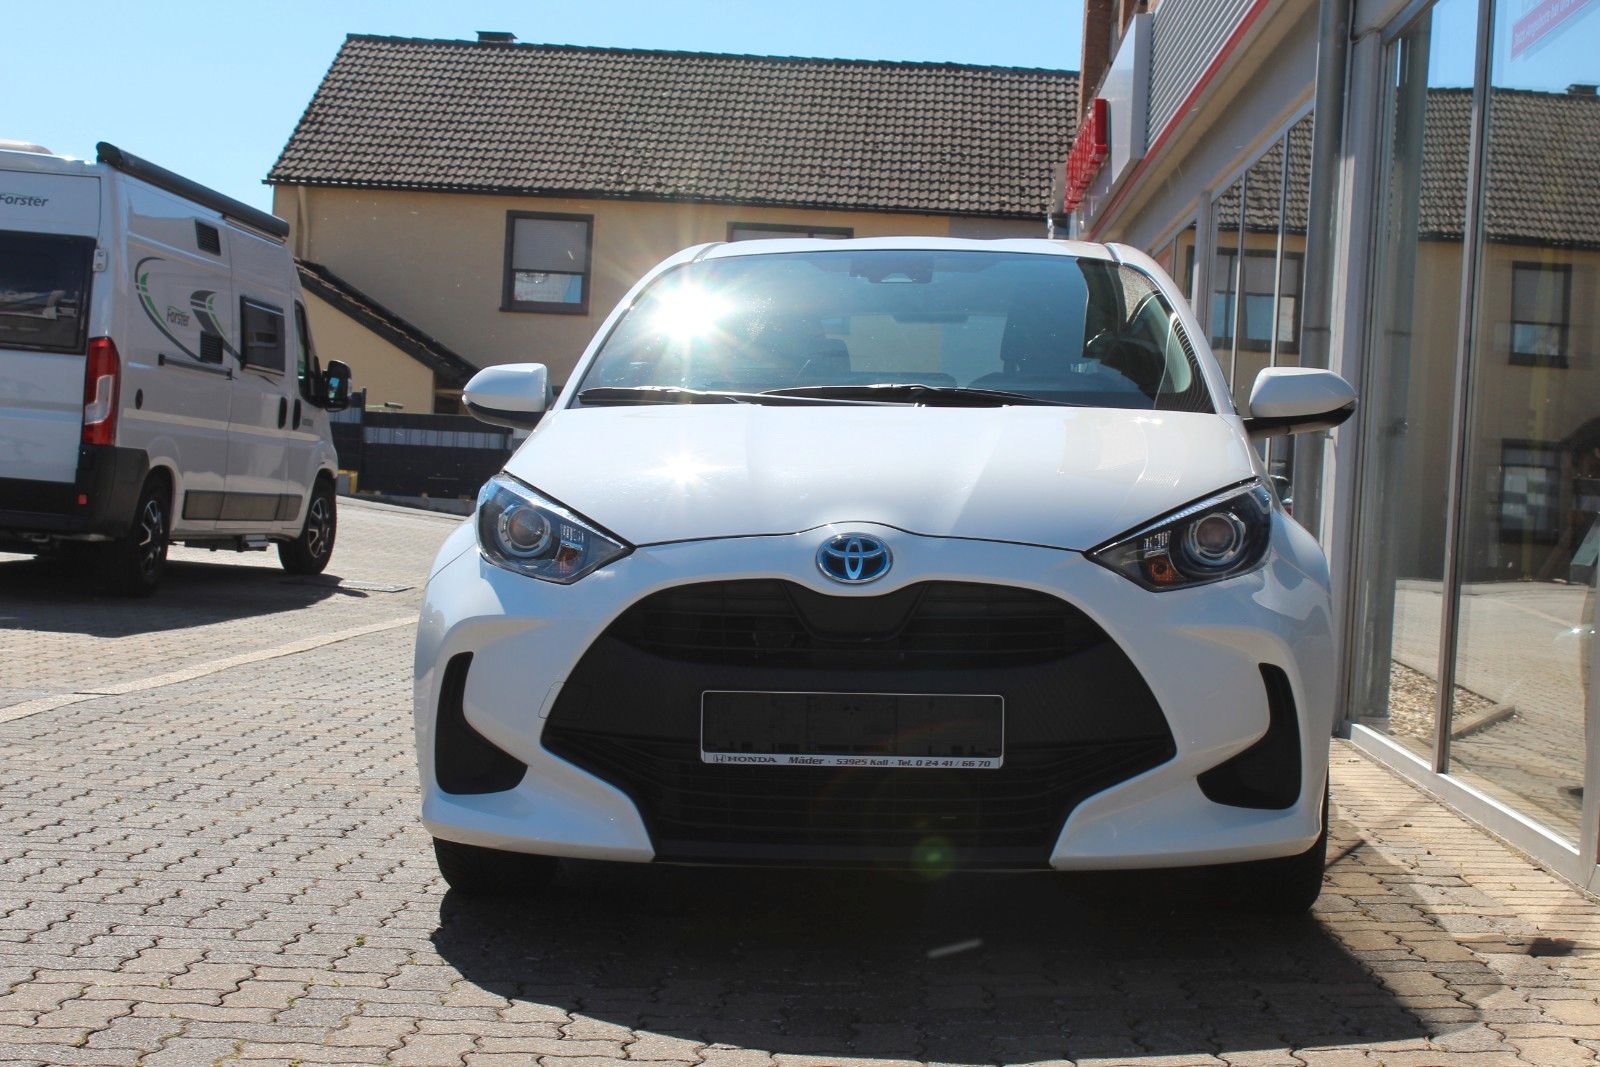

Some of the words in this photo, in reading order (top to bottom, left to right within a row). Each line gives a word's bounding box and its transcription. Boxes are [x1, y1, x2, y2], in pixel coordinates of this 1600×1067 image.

[727, 756, 777, 764] HONDA
[788, 756, 825, 765] Mäder
[835, 758, 868, 766] 53925
[869, 759, 889, 767] Kall
[898, 759, 913, 767] Tel.
